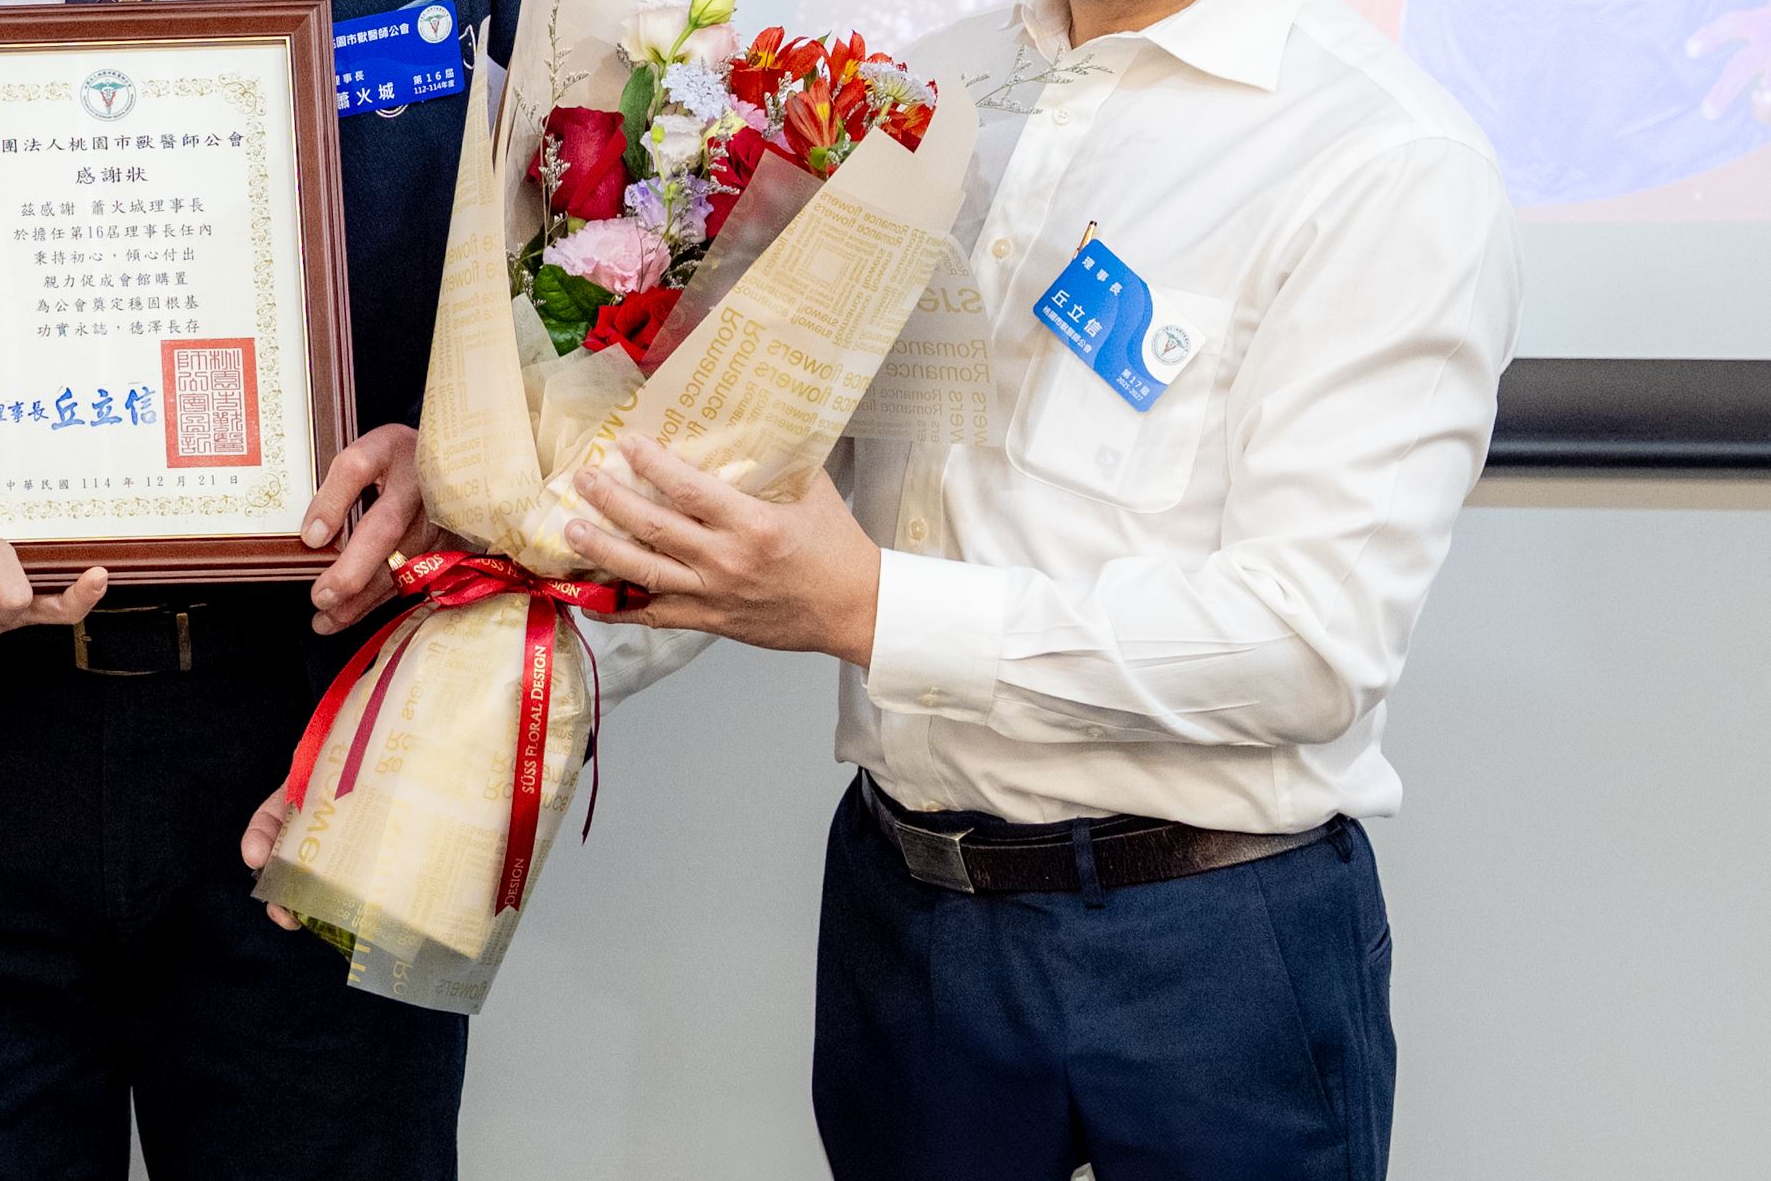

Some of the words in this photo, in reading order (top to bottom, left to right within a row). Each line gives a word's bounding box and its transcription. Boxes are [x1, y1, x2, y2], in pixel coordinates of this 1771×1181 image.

[75, 166, 149, 185] 感謝狀
[43, 271, 189, 289] 親力促成會館購置
[1082, 256, 1123, 296] 理事長
[1051, 289, 1103, 338] 丘立信
[522, 761, 538, 794] SÜSS
[530, 645, 547, 701] DESIGN
[504, 857, 526, 906] DESIGN
